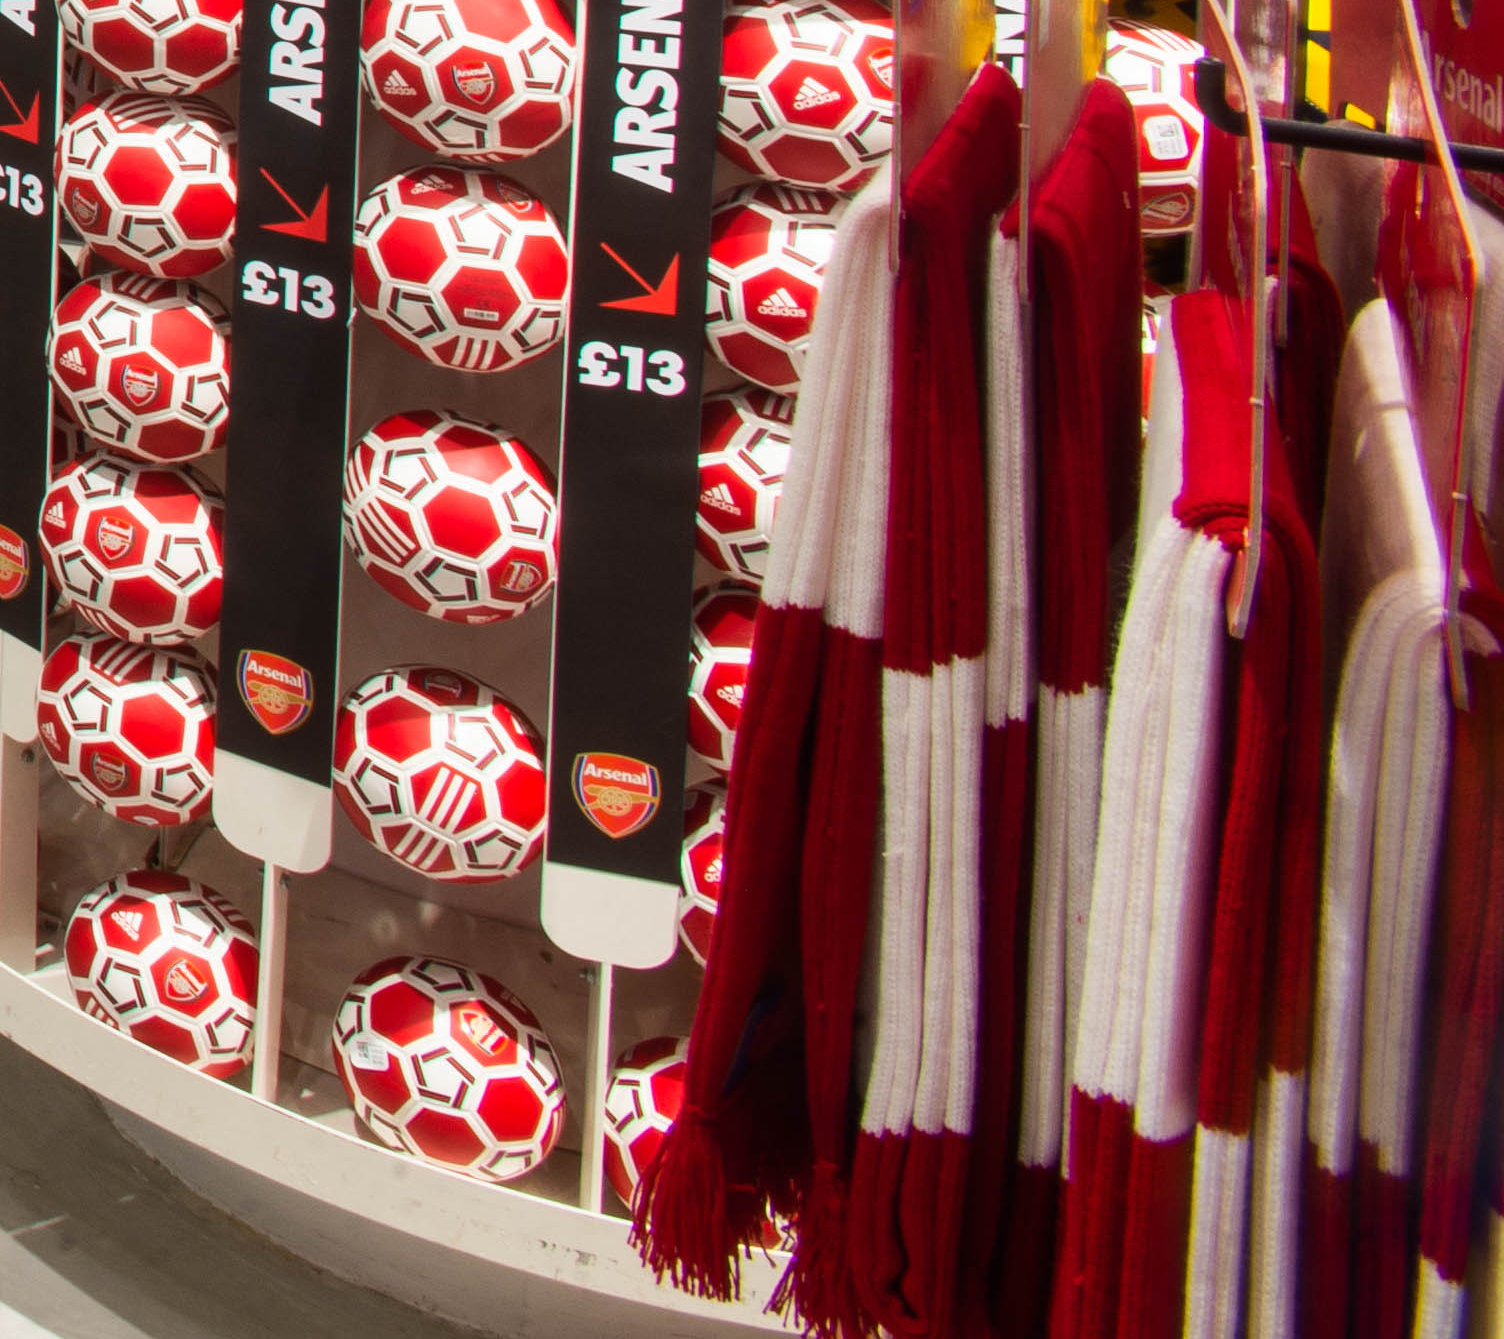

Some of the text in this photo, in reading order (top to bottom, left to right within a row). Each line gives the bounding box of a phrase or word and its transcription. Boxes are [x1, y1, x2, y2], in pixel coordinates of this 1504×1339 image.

[452, 64, 492, 83] Arsenal
[793, 89, 840, 112] adidas
[241, 259, 337, 319] £13
[758, 305, 807, 319] adidas
[577, 340, 687, 398] £13
[246, 659, 305, 692] Arsenal
[584, 761, 648, 787] Arsenal
